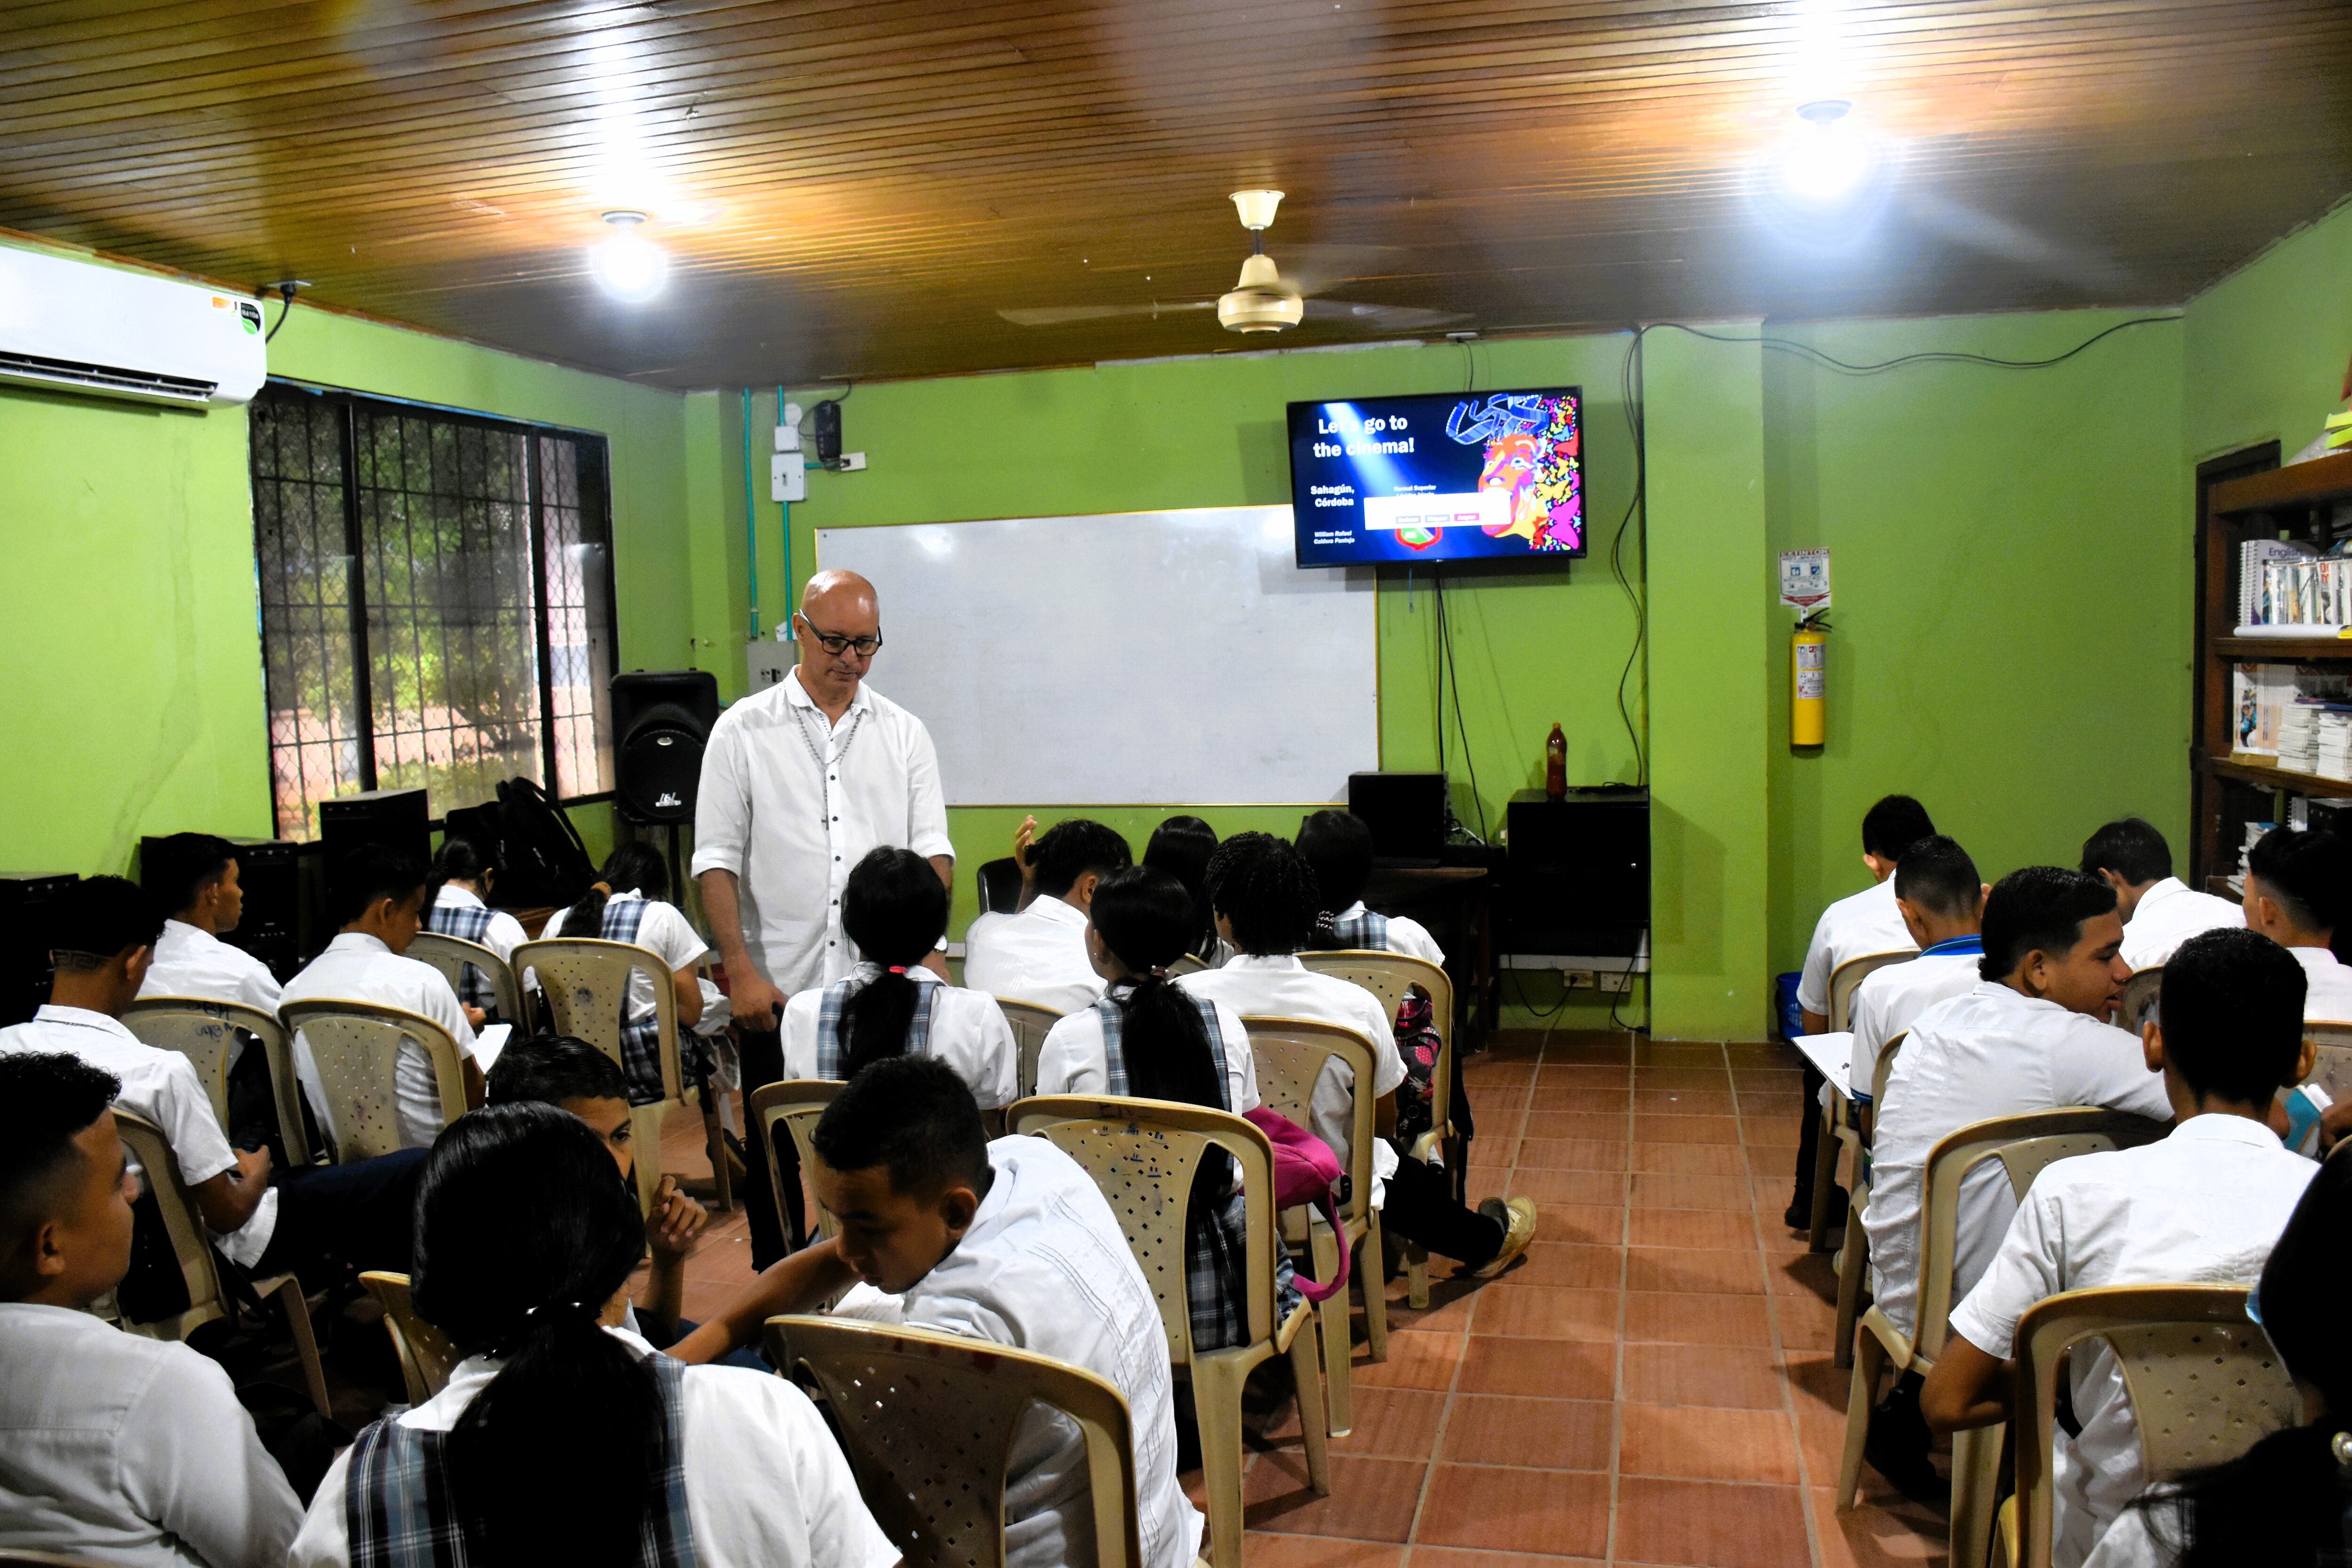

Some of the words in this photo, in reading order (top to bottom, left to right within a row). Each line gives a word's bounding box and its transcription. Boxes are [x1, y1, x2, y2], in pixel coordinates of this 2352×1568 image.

[1319, 418, 1359, 434] Let's
[1364, 418, 1386, 434] go
[1389, 415, 1407, 430] to
[1313, 442, 1342, 458] the
[1346, 438, 1414, 455] cinema!
[1311, 484, 1355, 495] Sahagún,
[1315, 497, 1354, 507] Córdoba
[2269, 547, 2301, 558] English
